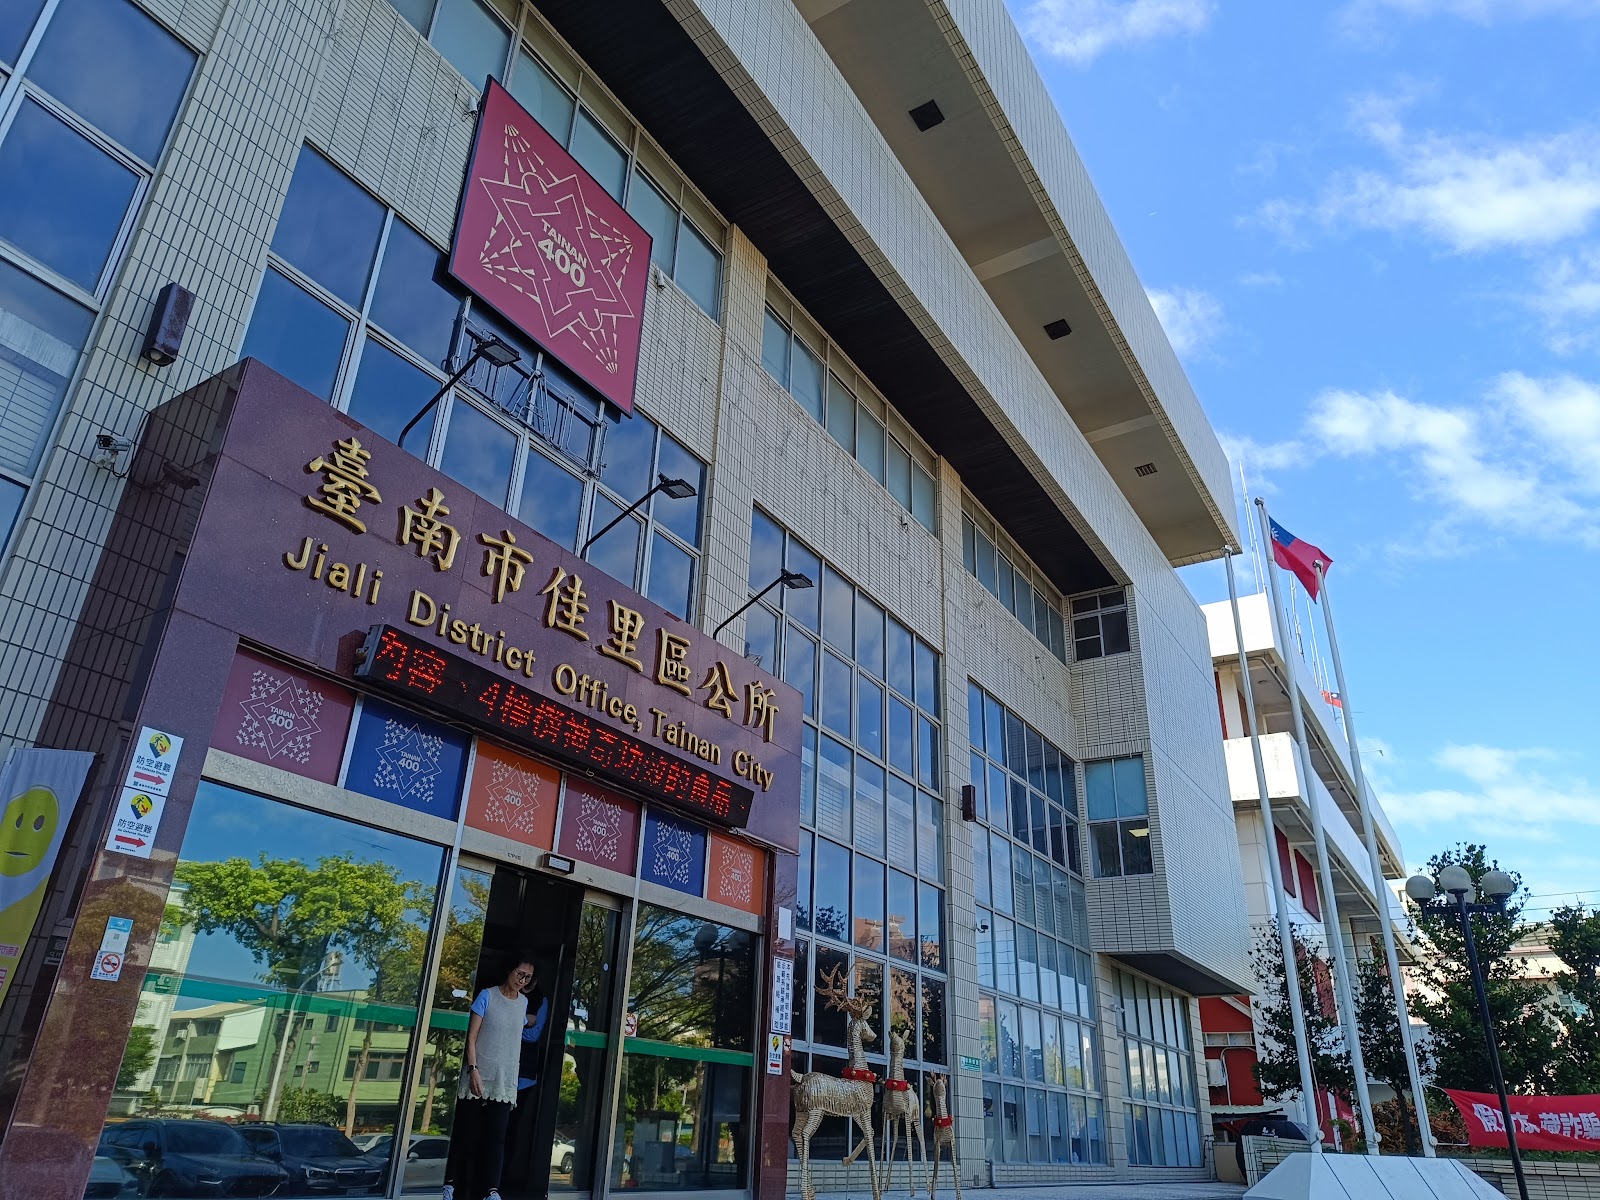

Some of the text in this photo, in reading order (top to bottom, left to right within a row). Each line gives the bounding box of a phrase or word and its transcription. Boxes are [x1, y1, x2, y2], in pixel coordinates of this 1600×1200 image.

[541, 218, 588, 269] TAINAN
[538, 239, 586, 288] 400
[305, 436, 780, 743] 臺南市佳里區公所
[286, 537, 774, 792] Jiali District Office, Tainan City
[270, 706, 296, 720] TAINAN
[267, 714, 294, 730] 400
[136, 755, 172, 773] 防空避難
[400, 751, 422, 763] TAINAN
[398, 758, 420, 772] 400
[505, 787, 523, 798] TAINAN
[504, 794, 522, 807] 400
[117, 818, 153, 835] 防空避難
[592, 825, 607, 836] 400
[667, 851, 680, 861] 400
[731, 872, 742, 882] 400
